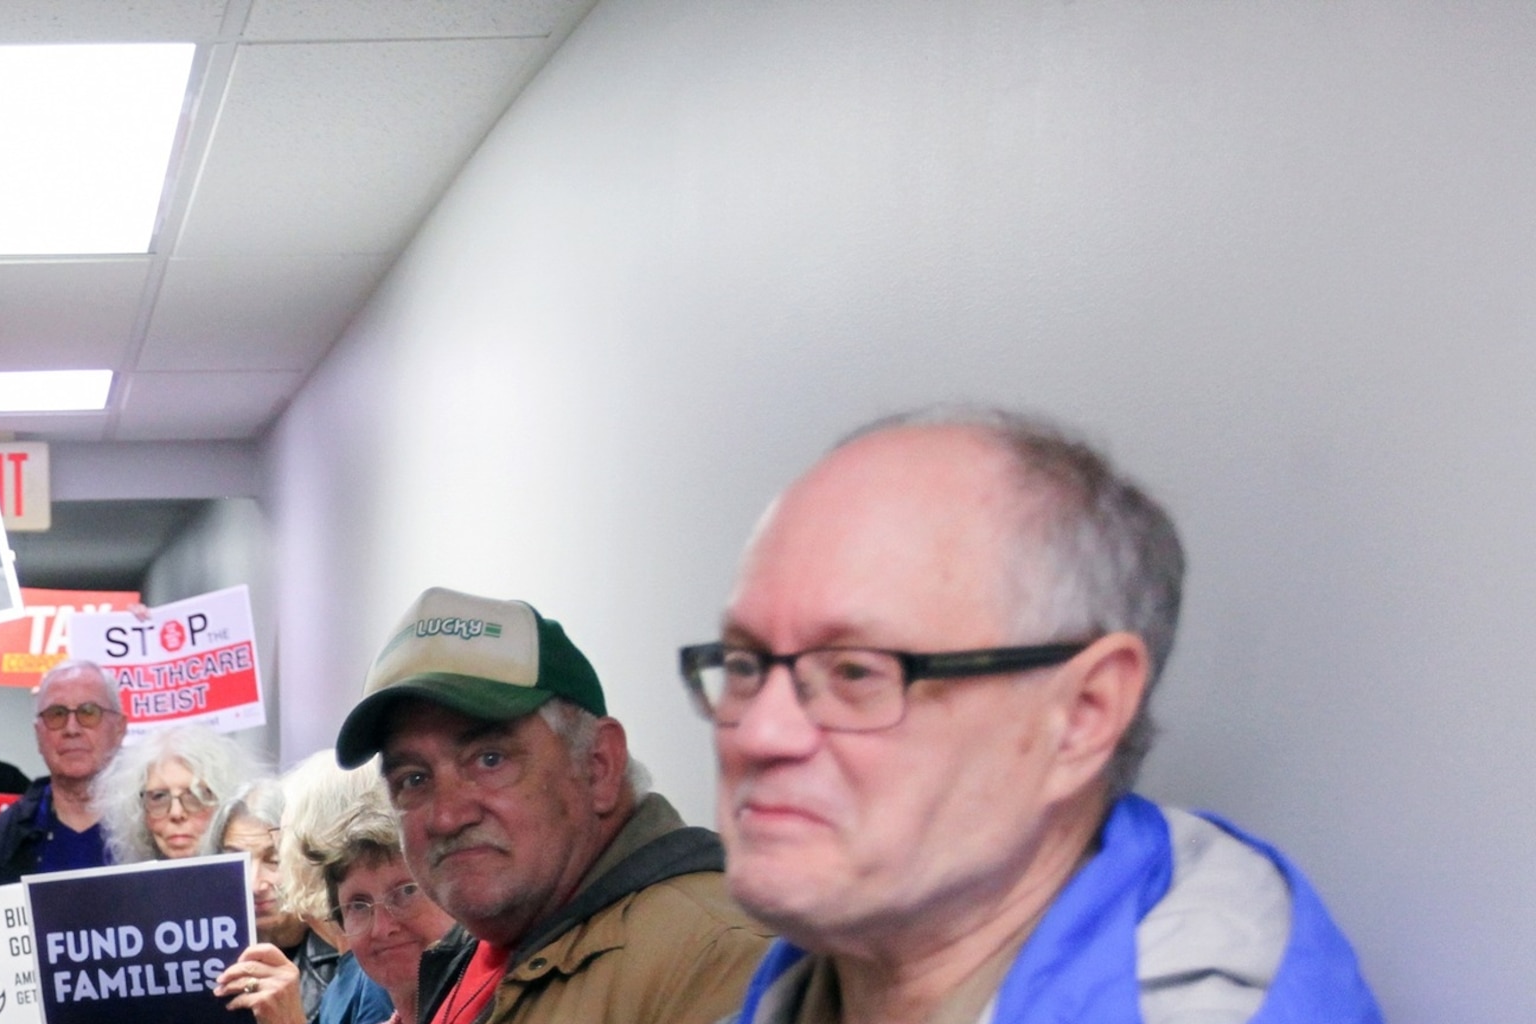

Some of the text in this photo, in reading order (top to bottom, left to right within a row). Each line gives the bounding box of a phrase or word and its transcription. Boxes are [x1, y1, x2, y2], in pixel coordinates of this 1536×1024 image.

[23, 603, 112, 656] TA
[105, 612, 208, 658] STOP
[416, 617, 484, 640] LUCKY
[132, 685, 208, 715] HEIST
[46, 915, 239, 964] FUND OUR
[54, 957, 226, 1003] FAMILIES
